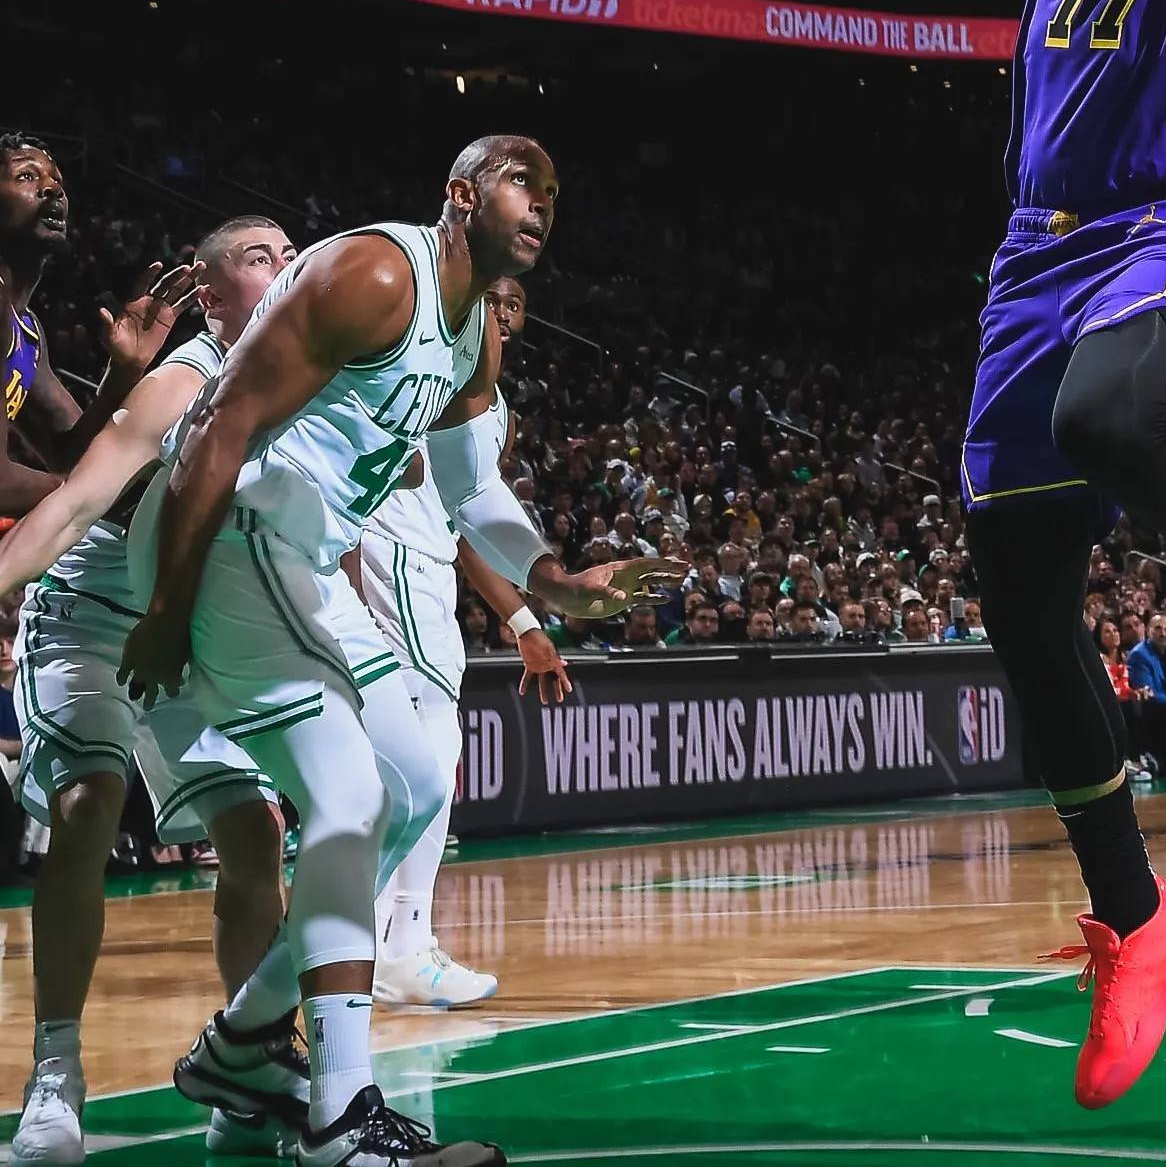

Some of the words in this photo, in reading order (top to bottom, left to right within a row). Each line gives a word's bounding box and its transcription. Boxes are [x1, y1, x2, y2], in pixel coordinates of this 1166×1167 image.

[764, 5, 878, 48] COMMAND
[881, 17, 909, 51] THE
[913, 20, 974, 53] BALL
[540, 700, 661, 796] WHERE
[668, 696, 747, 784] FANS
[752, 691, 866, 779] ALWAYS
[870, 689, 935, 770] WIN.
